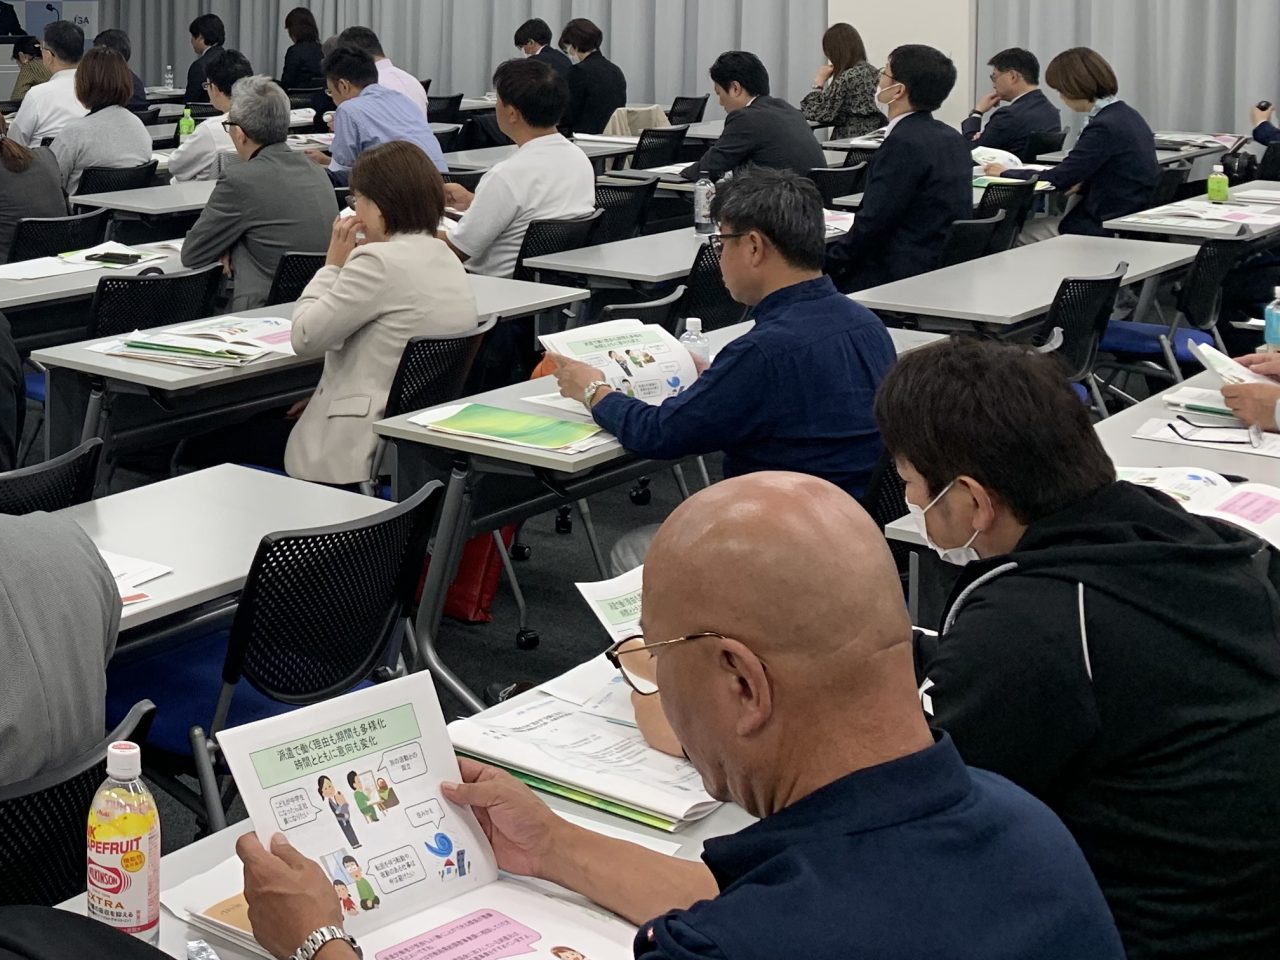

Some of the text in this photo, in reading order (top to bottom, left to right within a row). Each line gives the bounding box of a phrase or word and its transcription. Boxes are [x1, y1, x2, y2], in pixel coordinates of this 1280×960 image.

[277, 718, 387, 762] 派遣で働く理由も期間も多様化
[293, 735, 378, 771] 時間とともに意向も変化
